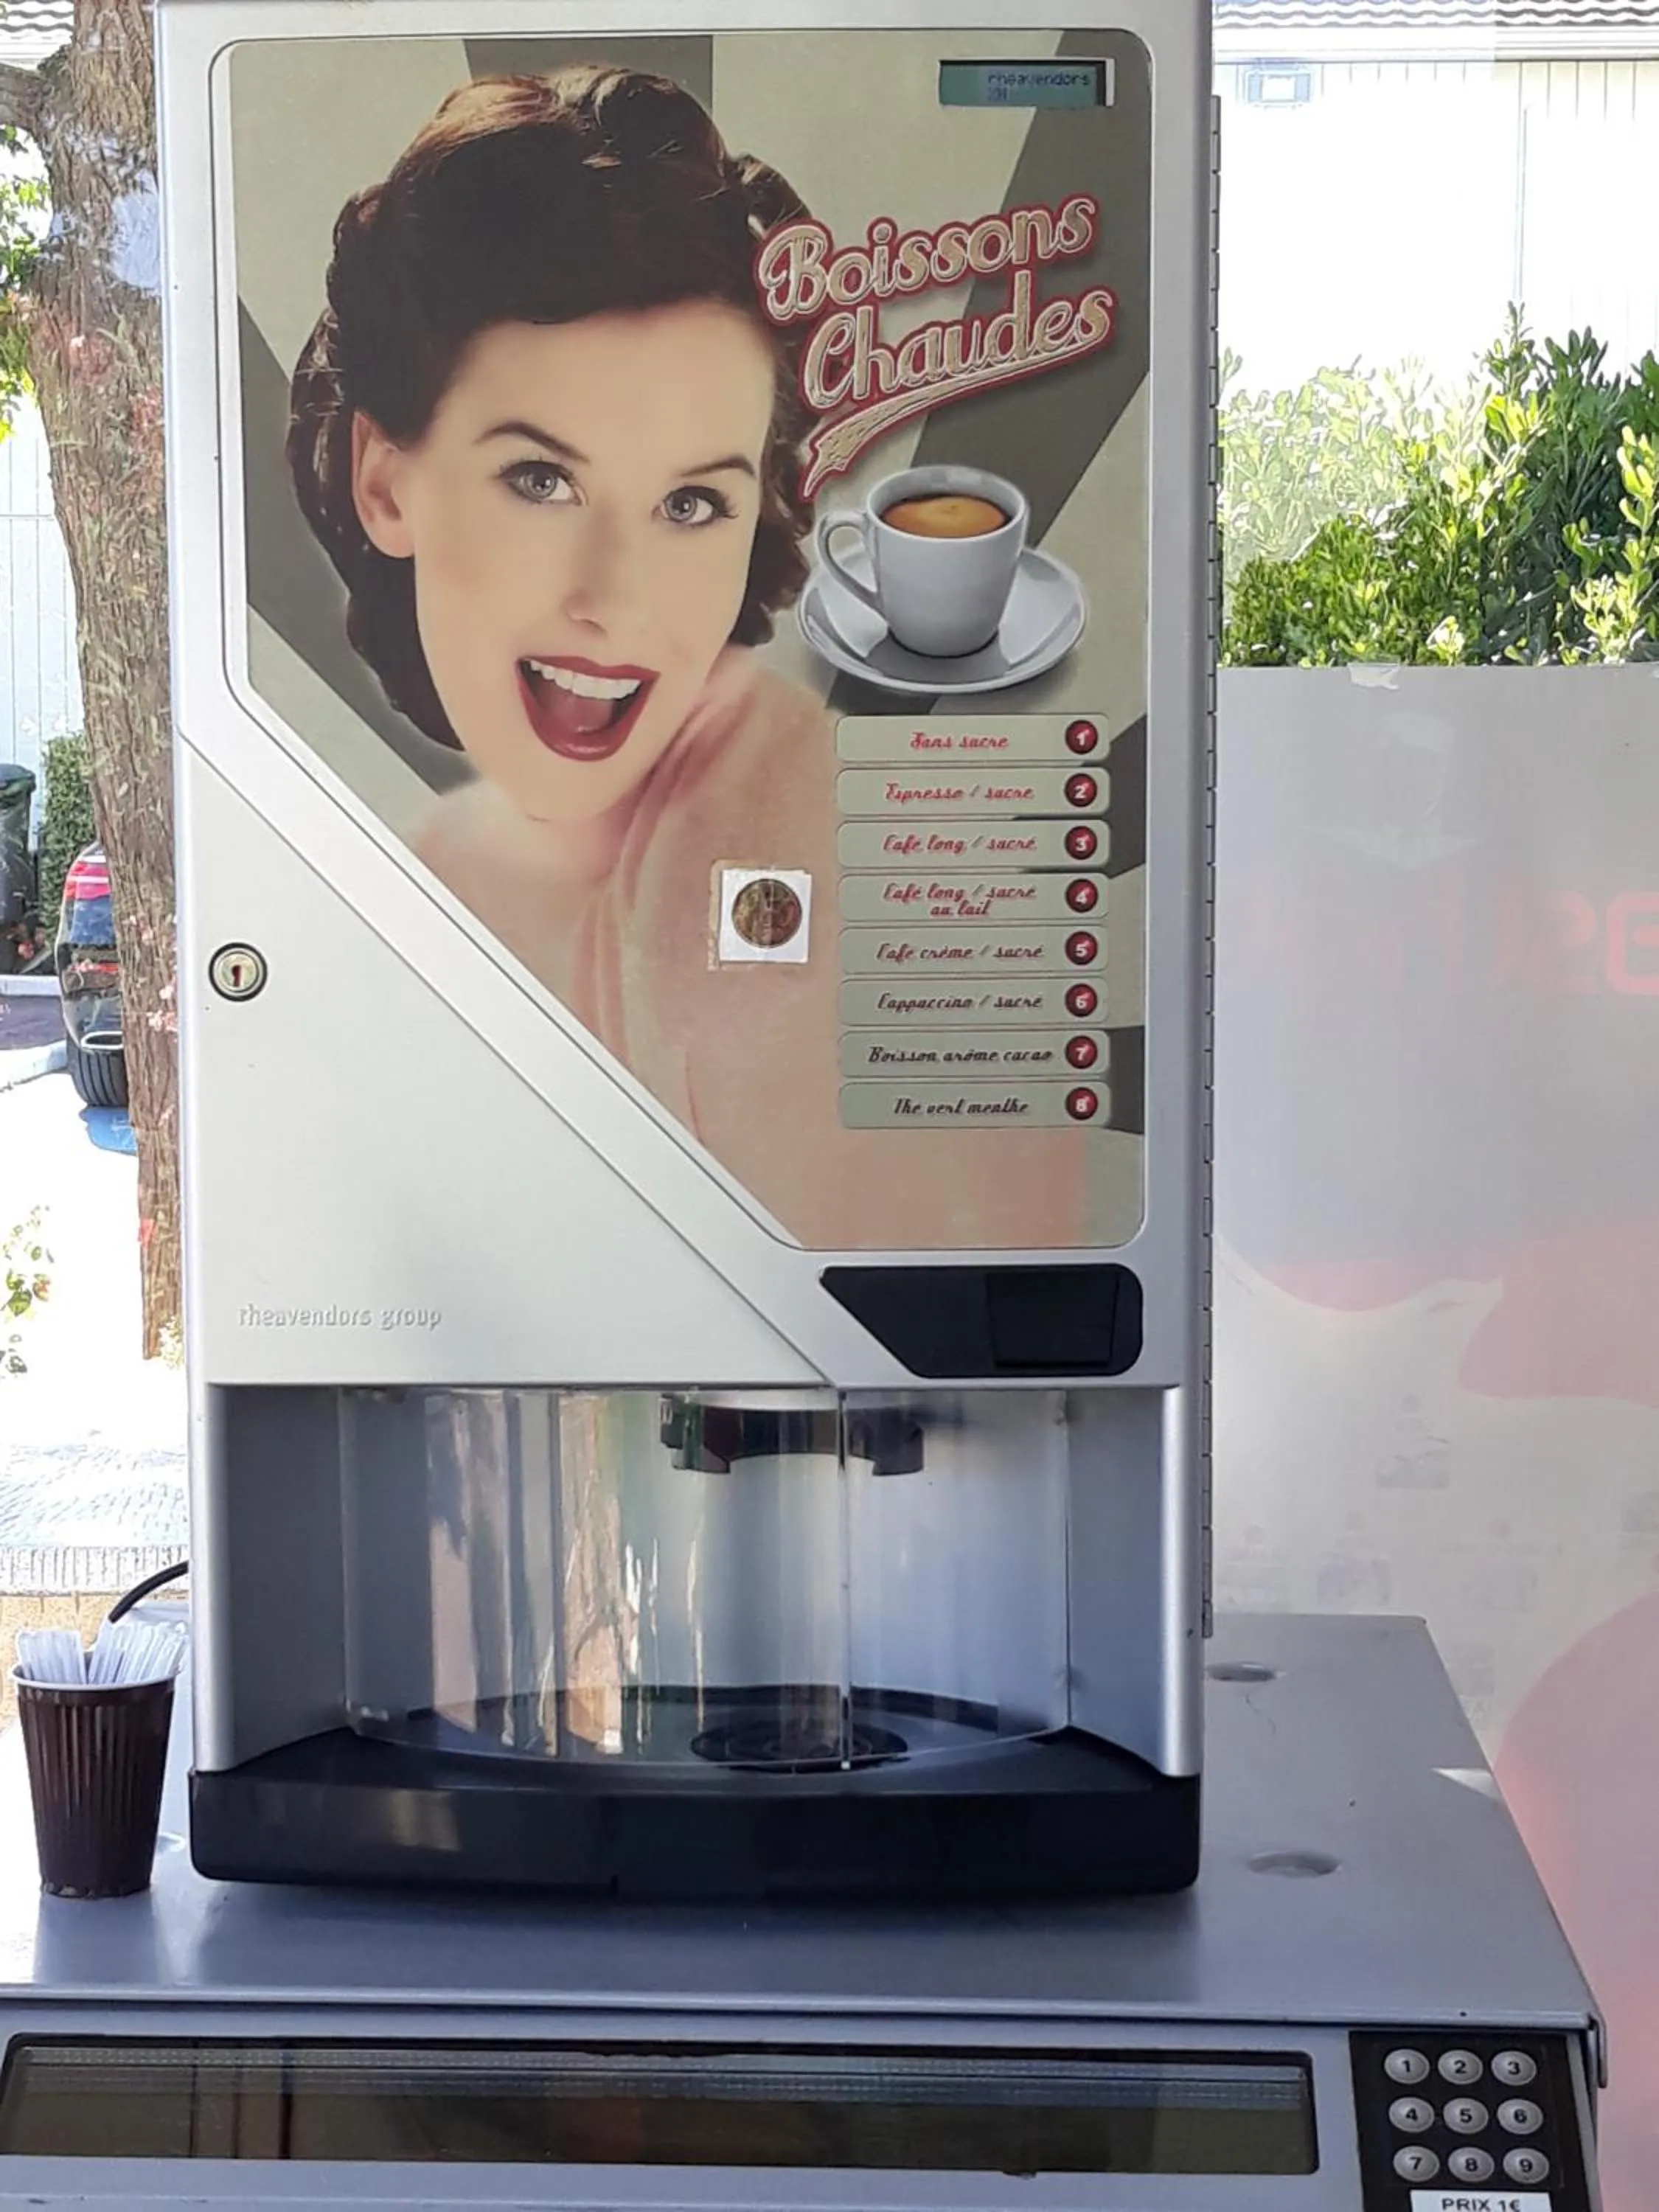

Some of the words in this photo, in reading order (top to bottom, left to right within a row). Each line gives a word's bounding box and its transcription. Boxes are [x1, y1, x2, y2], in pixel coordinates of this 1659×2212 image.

[757, 195, 1099, 321] Boissons
[803, 269, 1114, 410] Chaudes
[1076, 731, 1087, 746] 1
[1074, 785, 1087, 799] 2
[926, 834, 964, 855] long
[1075, 837, 1088, 852] 3
[926, 883, 964, 902] long
[1075, 890, 1088, 905] 4
[957, 900, 992, 915] lait
[1075, 942, 1088, 957] 5
[877, 992, 973, 1012] Cappuccino
[1075, 995, 1087, 1009] 6
[868, 1046, 936, 1062] Boisson
[1003, 1050, 1052, 1061] cacao
[1075, 1046, 1088, 1061] 7
[927, 1098, 964, 1114] vert
[967, 1096, 1029, 1114] menthe
[1075, 1098, 1088, 1113] 8
[380, 1308, 442, 1331] group
[1402, 2059, 1411, 2073] 1
[1454, 2059, 1467, 2075] 2
[1506, 2061, 1520, 2076] 3
[1405, 2108, 1419, 2122] 4
[1459, 2108, 1472, 2124] 5
[1513, 2108, 1527, 2124] 6
[1409, 2156, 1422, 2171] 7
[1464, 2157, 1478, 2172] 8
[1519, 2157, 1533, 2173] 9
[1441, 2197, 1490, 2212] PRIX
[1498, 2199, 1521, 2212] 1€
